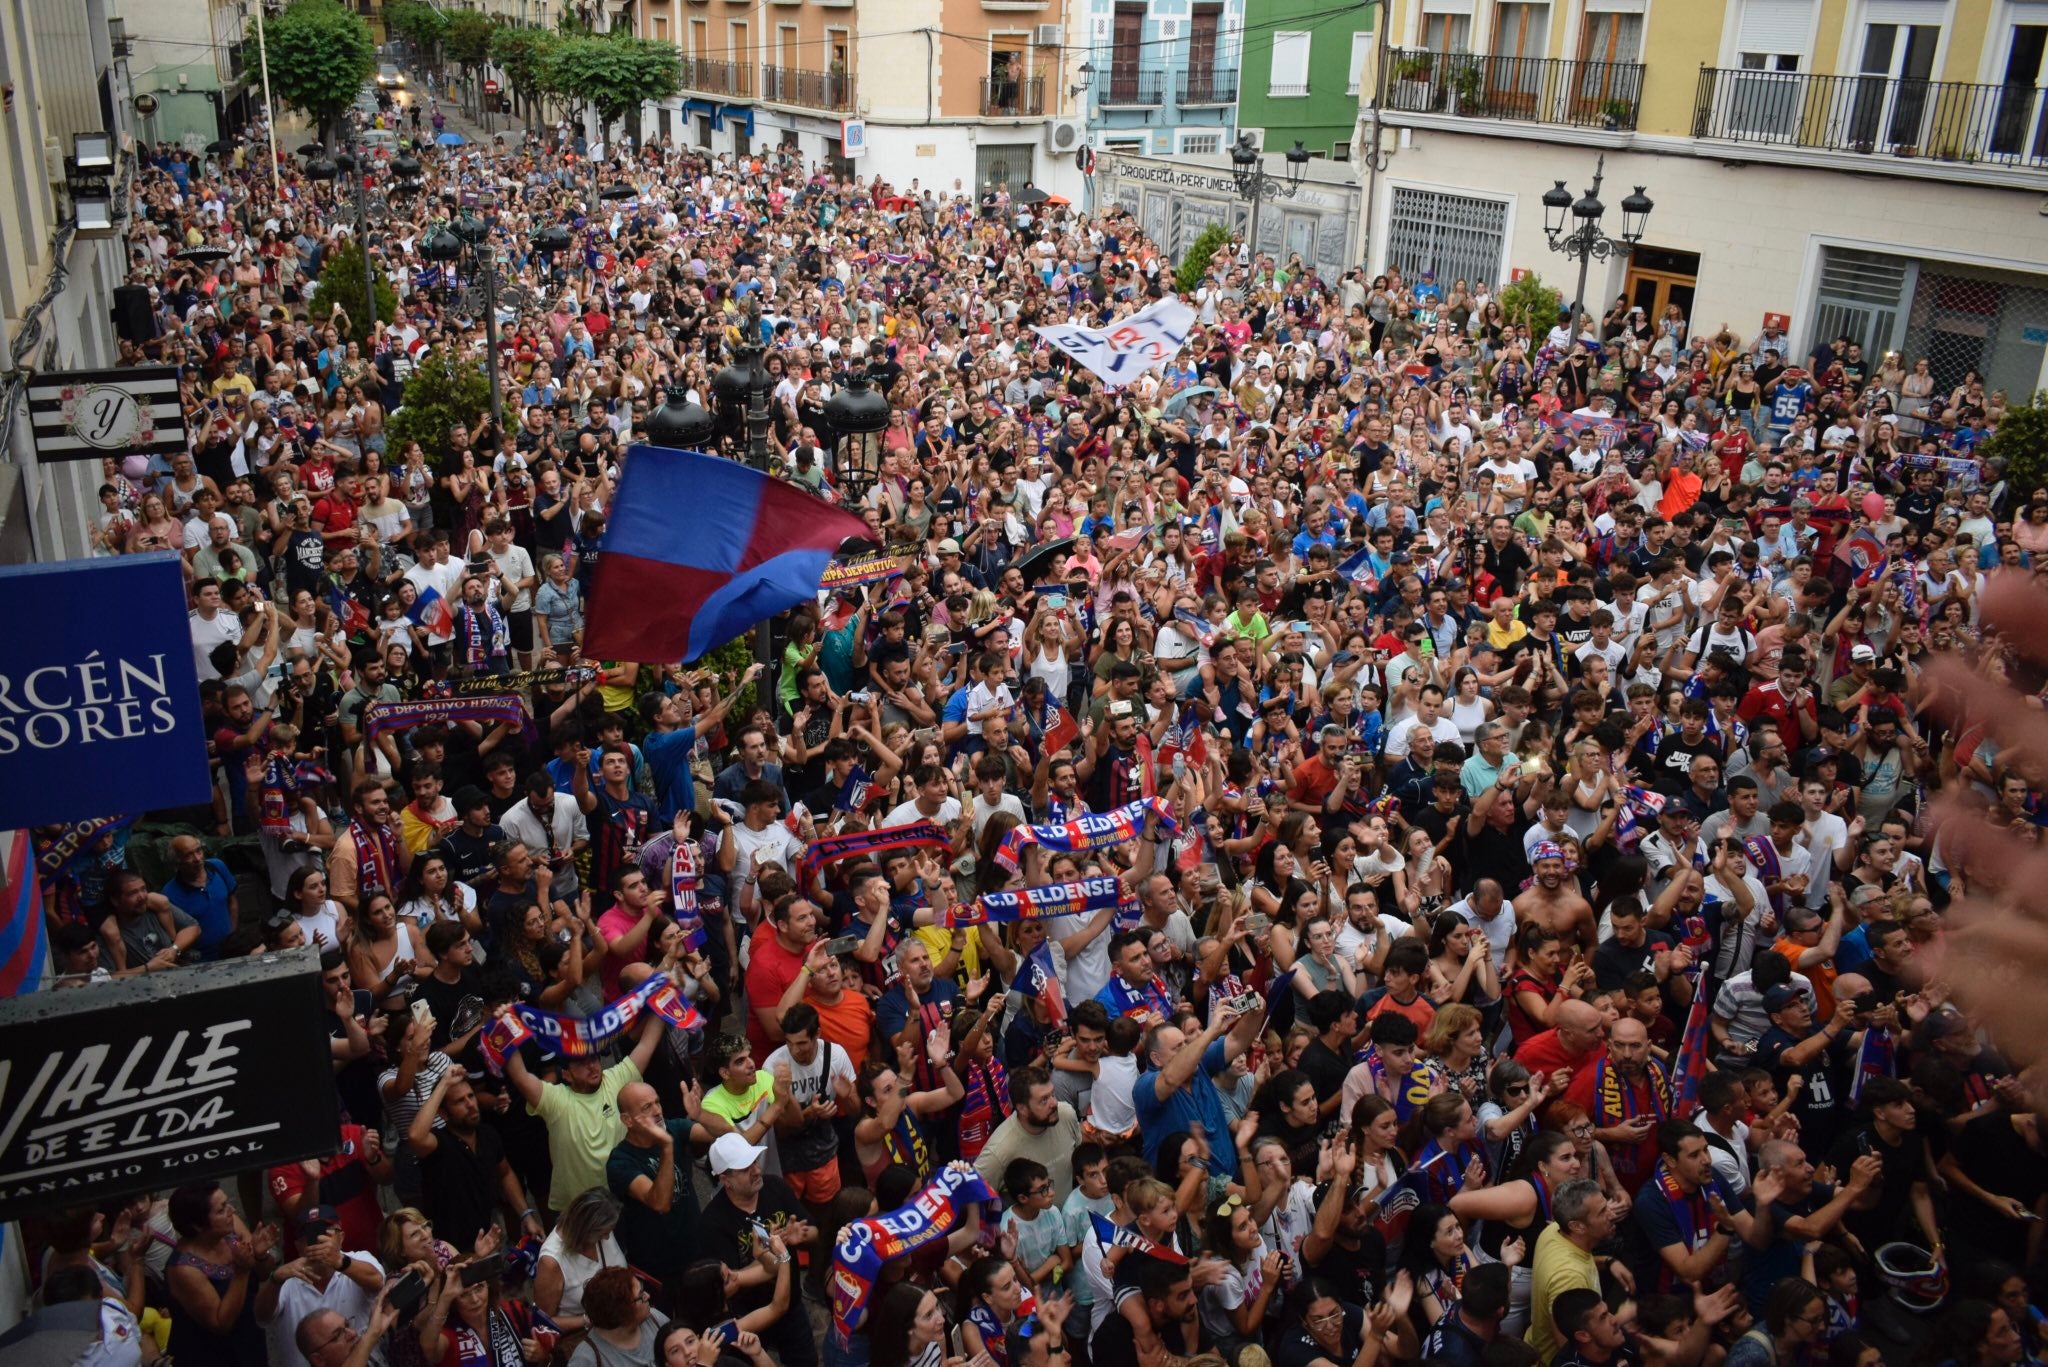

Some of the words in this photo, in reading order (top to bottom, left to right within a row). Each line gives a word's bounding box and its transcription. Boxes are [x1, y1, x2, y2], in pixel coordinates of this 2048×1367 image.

[1181, 174, 1241, 192] PERFUMERI
[1775, 397, 1800, 420] 55
[395, 700, 465, 715] DEPORTIVO
[0, 697, 176, 755] SORES
[1097, 829, 1130, 846] DEPORTIVO
[984, 892, 1025, 907] C.D.
[1029, 878, 1116, 904] ELDENSE
[1046, 902, 1082, 915] DEPORTIVO
[521, 1011, 568, 1040] C.D.
[0, 1019, 251, 1158] VALLE
[24, 1135, 67, 1164] DE
[80, 1096, 234, 1152] ELDA
[162, 1141, 264, 1168] LOCAL
